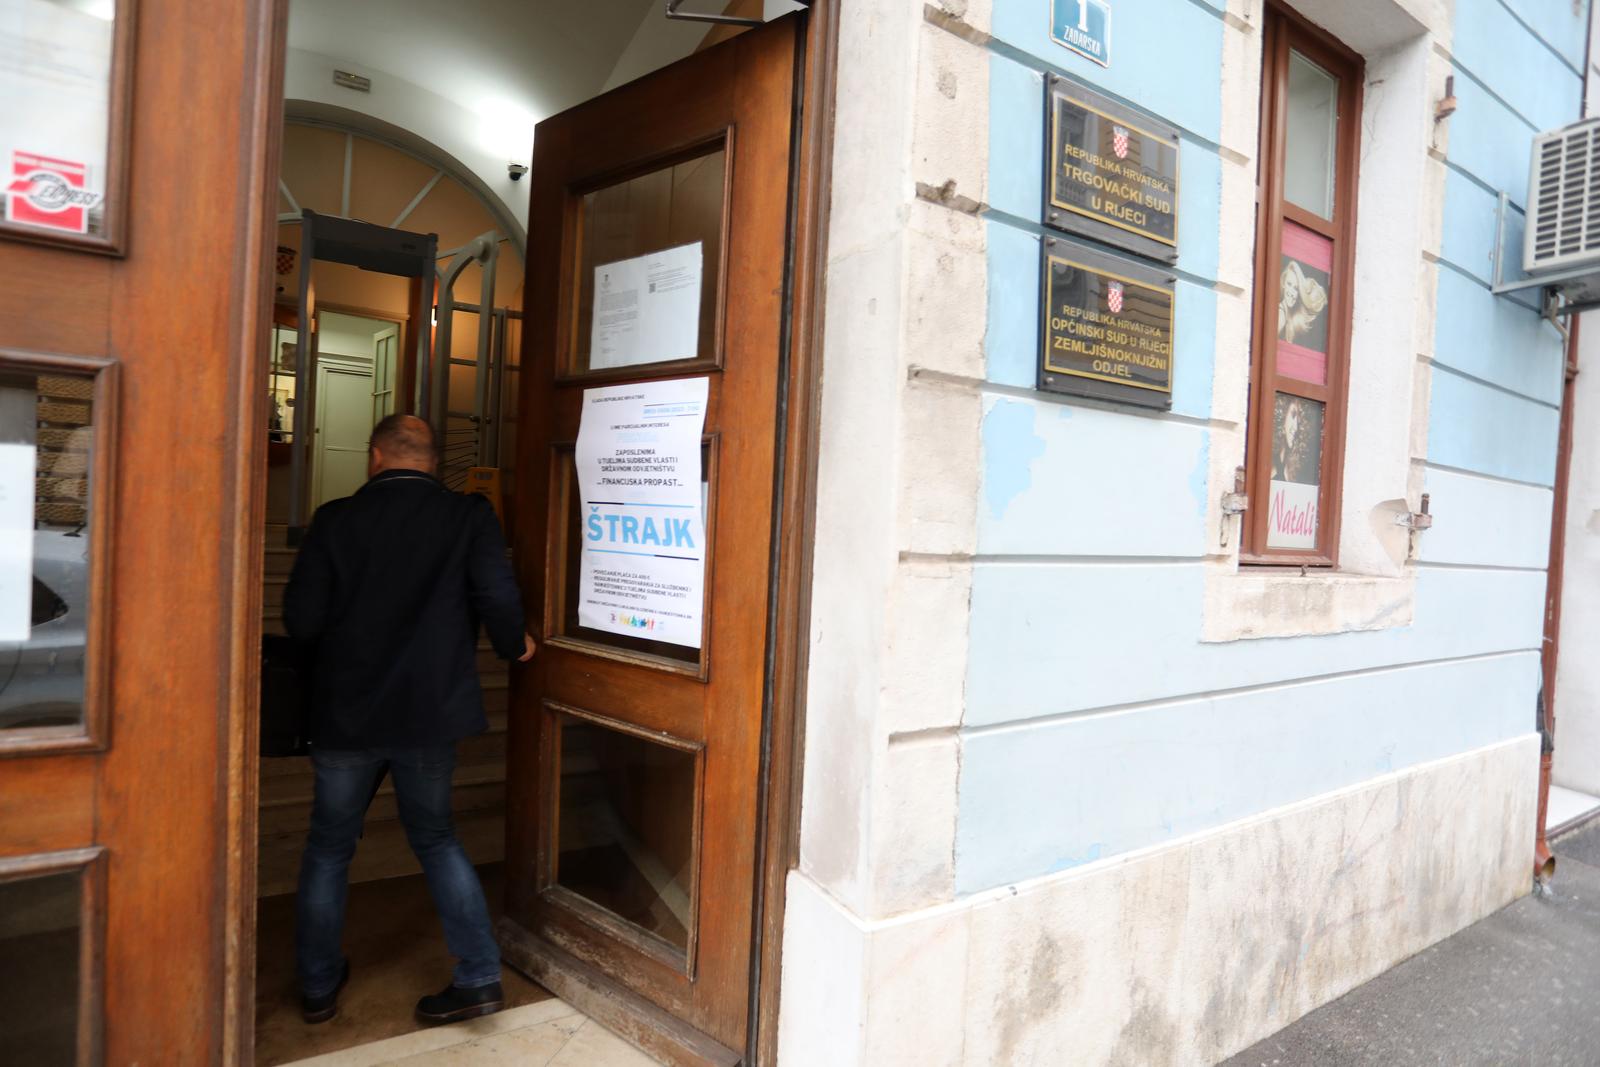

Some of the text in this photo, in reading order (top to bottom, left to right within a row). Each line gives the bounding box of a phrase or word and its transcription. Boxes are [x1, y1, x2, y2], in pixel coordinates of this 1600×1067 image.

[1077, 0, 1089, 32] 1
[1063, 25, 1101, 56] ZADARSKA
[1065, 144, 1170, 193] REPUBLIKA HRVATSKA
[1063, 162, 1171, 214] TRGOVAČKI SUD
[1091, 195, 1146, 226] U RIJECI
[1051, 317, 1169, 355] OPĆINSKI SUD U RIJECI
[1062, 304, 1162, 338] REPUBLIKA HRVATSKA
[1053, 335, 1167, 371] ZEMLJIŠNOKNJIŽNI
[1092, 359, 1132, 378] ODJEL
[587, 506, 696, 549] ŠTRAJK
[1269, 488, 1315, 536] Natali
